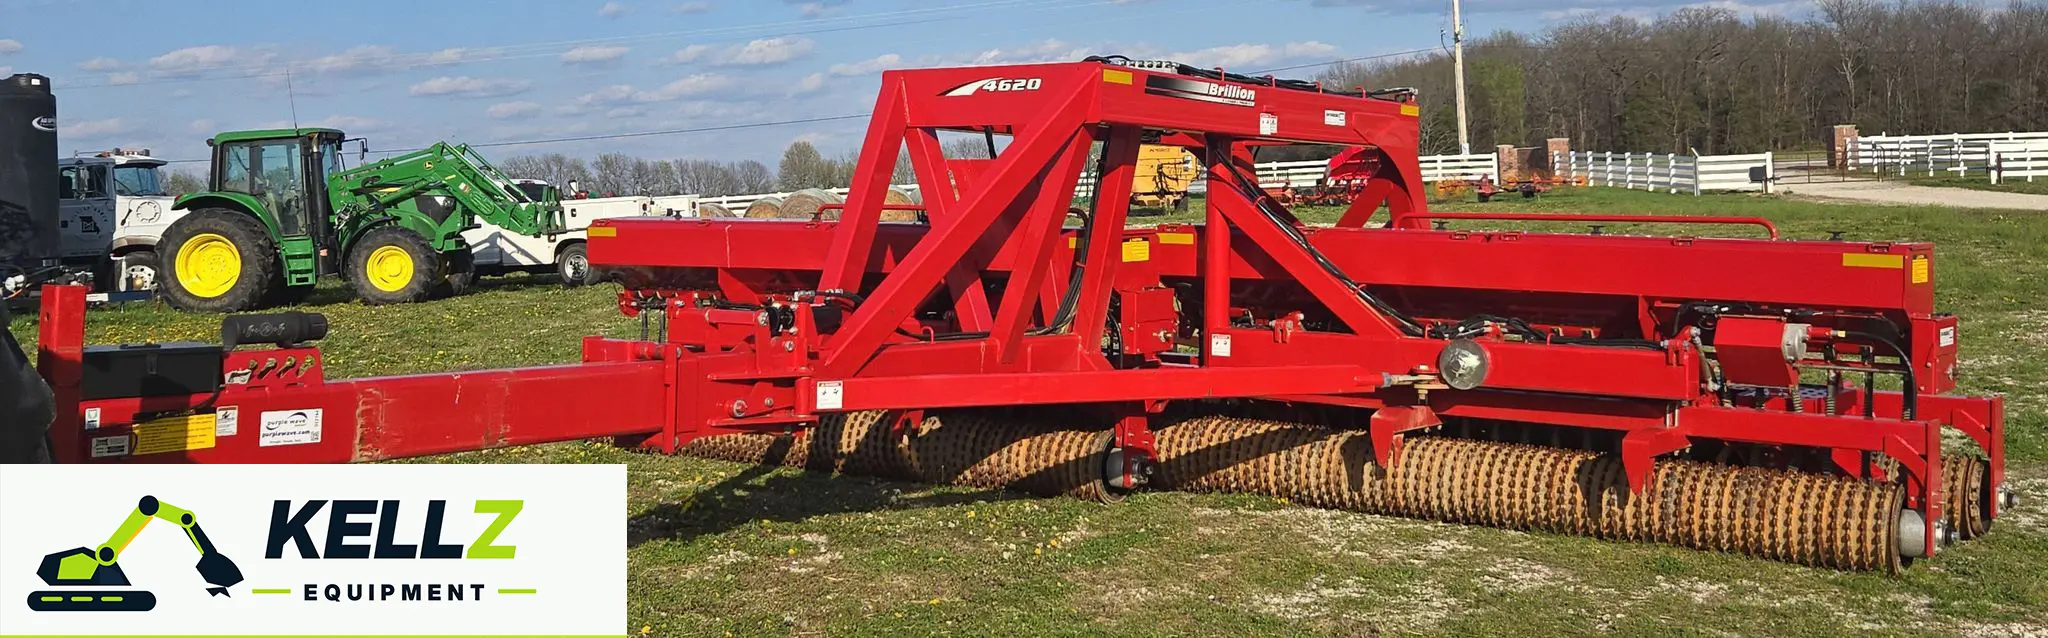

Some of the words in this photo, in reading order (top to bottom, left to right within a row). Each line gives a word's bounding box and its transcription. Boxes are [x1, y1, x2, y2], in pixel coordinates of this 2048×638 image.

[982, 78, 1042, 92] 4620
[1209, 82, 1256, 100] Brillion
[267, 419, 288, 427] purple
[262, 430, 310, 438] purplewave.com
